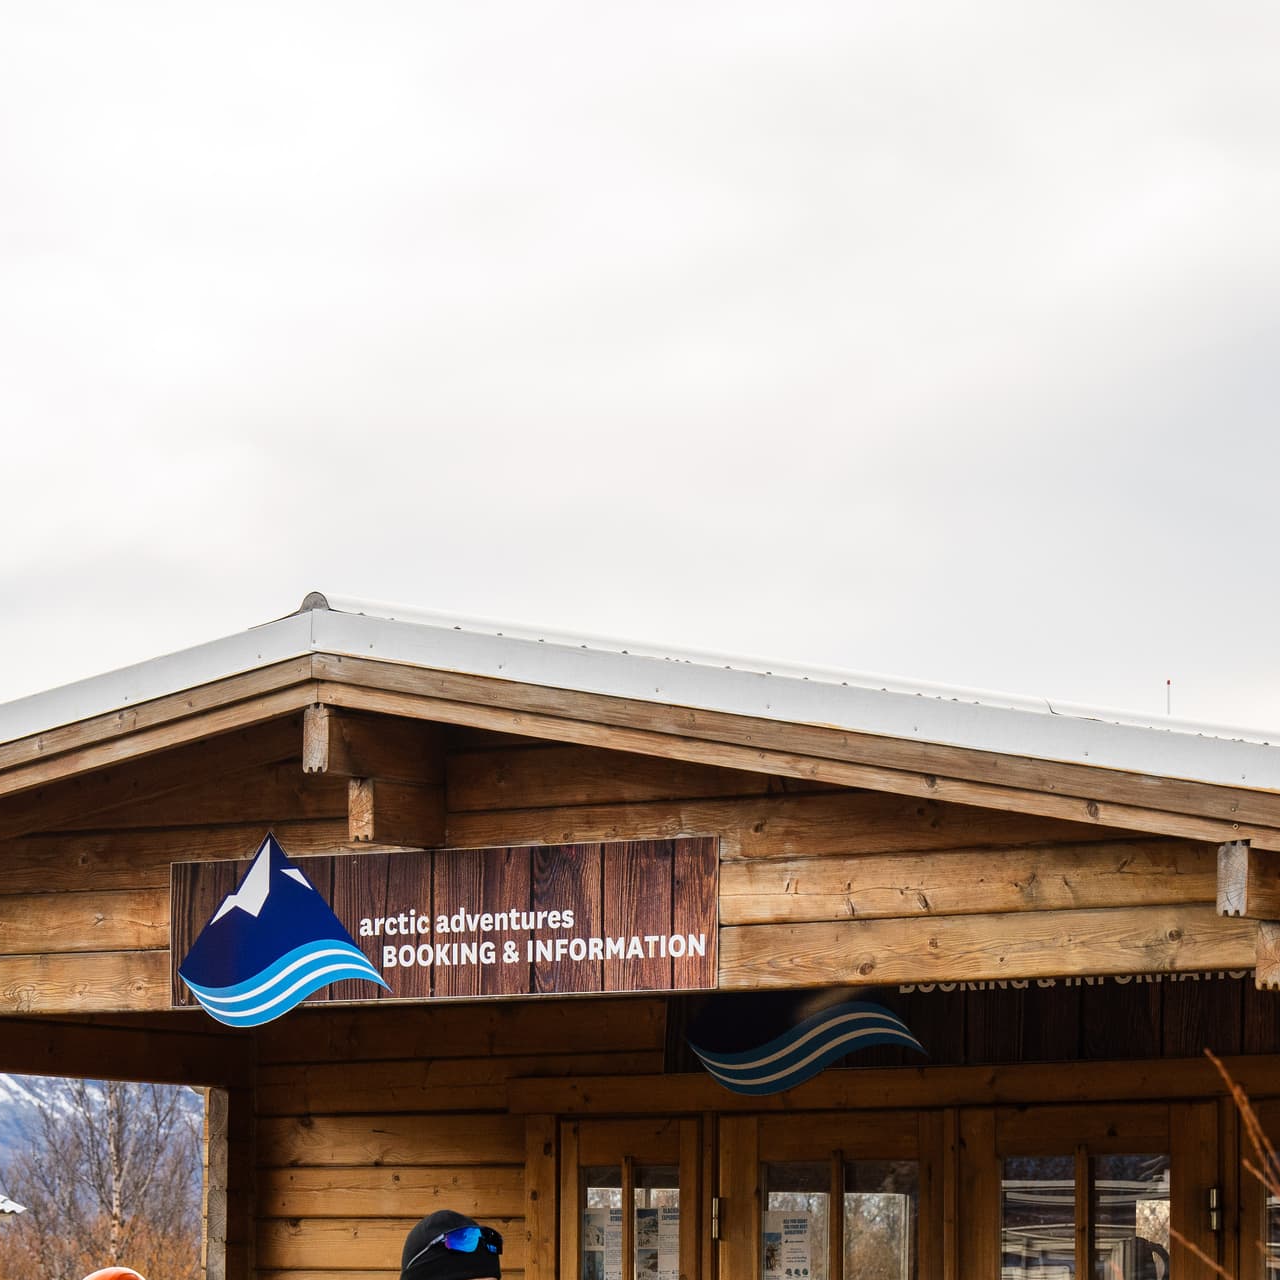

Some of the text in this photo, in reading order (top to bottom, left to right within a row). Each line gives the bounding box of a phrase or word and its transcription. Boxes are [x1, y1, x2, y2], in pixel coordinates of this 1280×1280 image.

[359, 907, 575, 937] arctic adventures
[382, 933, 706, 969] BOOKING & INFORMATION
